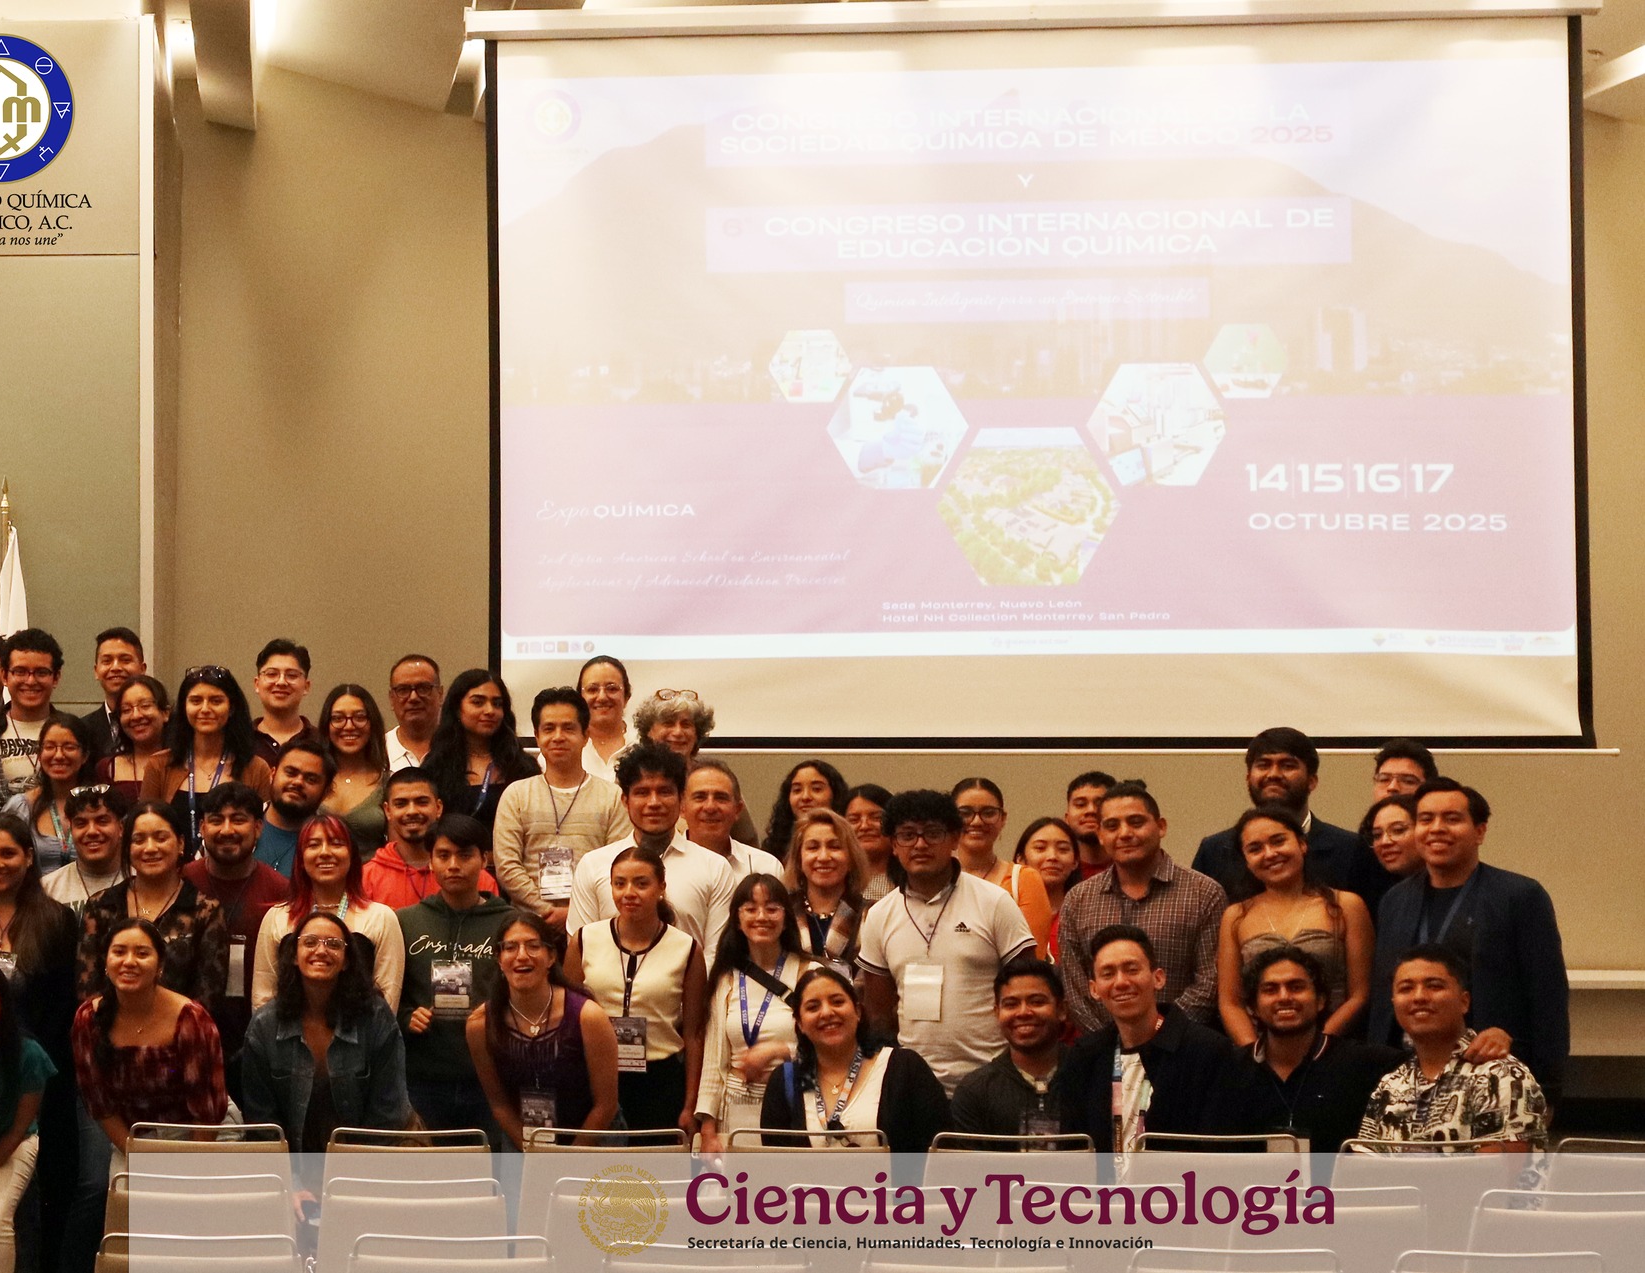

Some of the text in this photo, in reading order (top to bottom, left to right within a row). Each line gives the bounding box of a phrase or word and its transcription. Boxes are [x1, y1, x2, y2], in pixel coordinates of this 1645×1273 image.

[732, 104, 1310, 131] CONGRESO INTERNACIONAL DE LA
[720, 135, 892, 154] SOCIEDAD
[1054, 130, 1098, 147] DE
[1251, 125, 1334, 143] 2025
[1016, 173, 1034, 188] Y
[764, 208, 1334, 236] CONGRESO INTERNACIONAL DE
[837, 230, 1218, 259] EDUCACIÓN QUÍMICA
[1248, 513, 1507, 532] OCTUBRE 2025
[883, 612, 1171, 622] Hotel NH Collection Monterrey San Pedro
[756, 1010, 766, 1027] ZEISS
